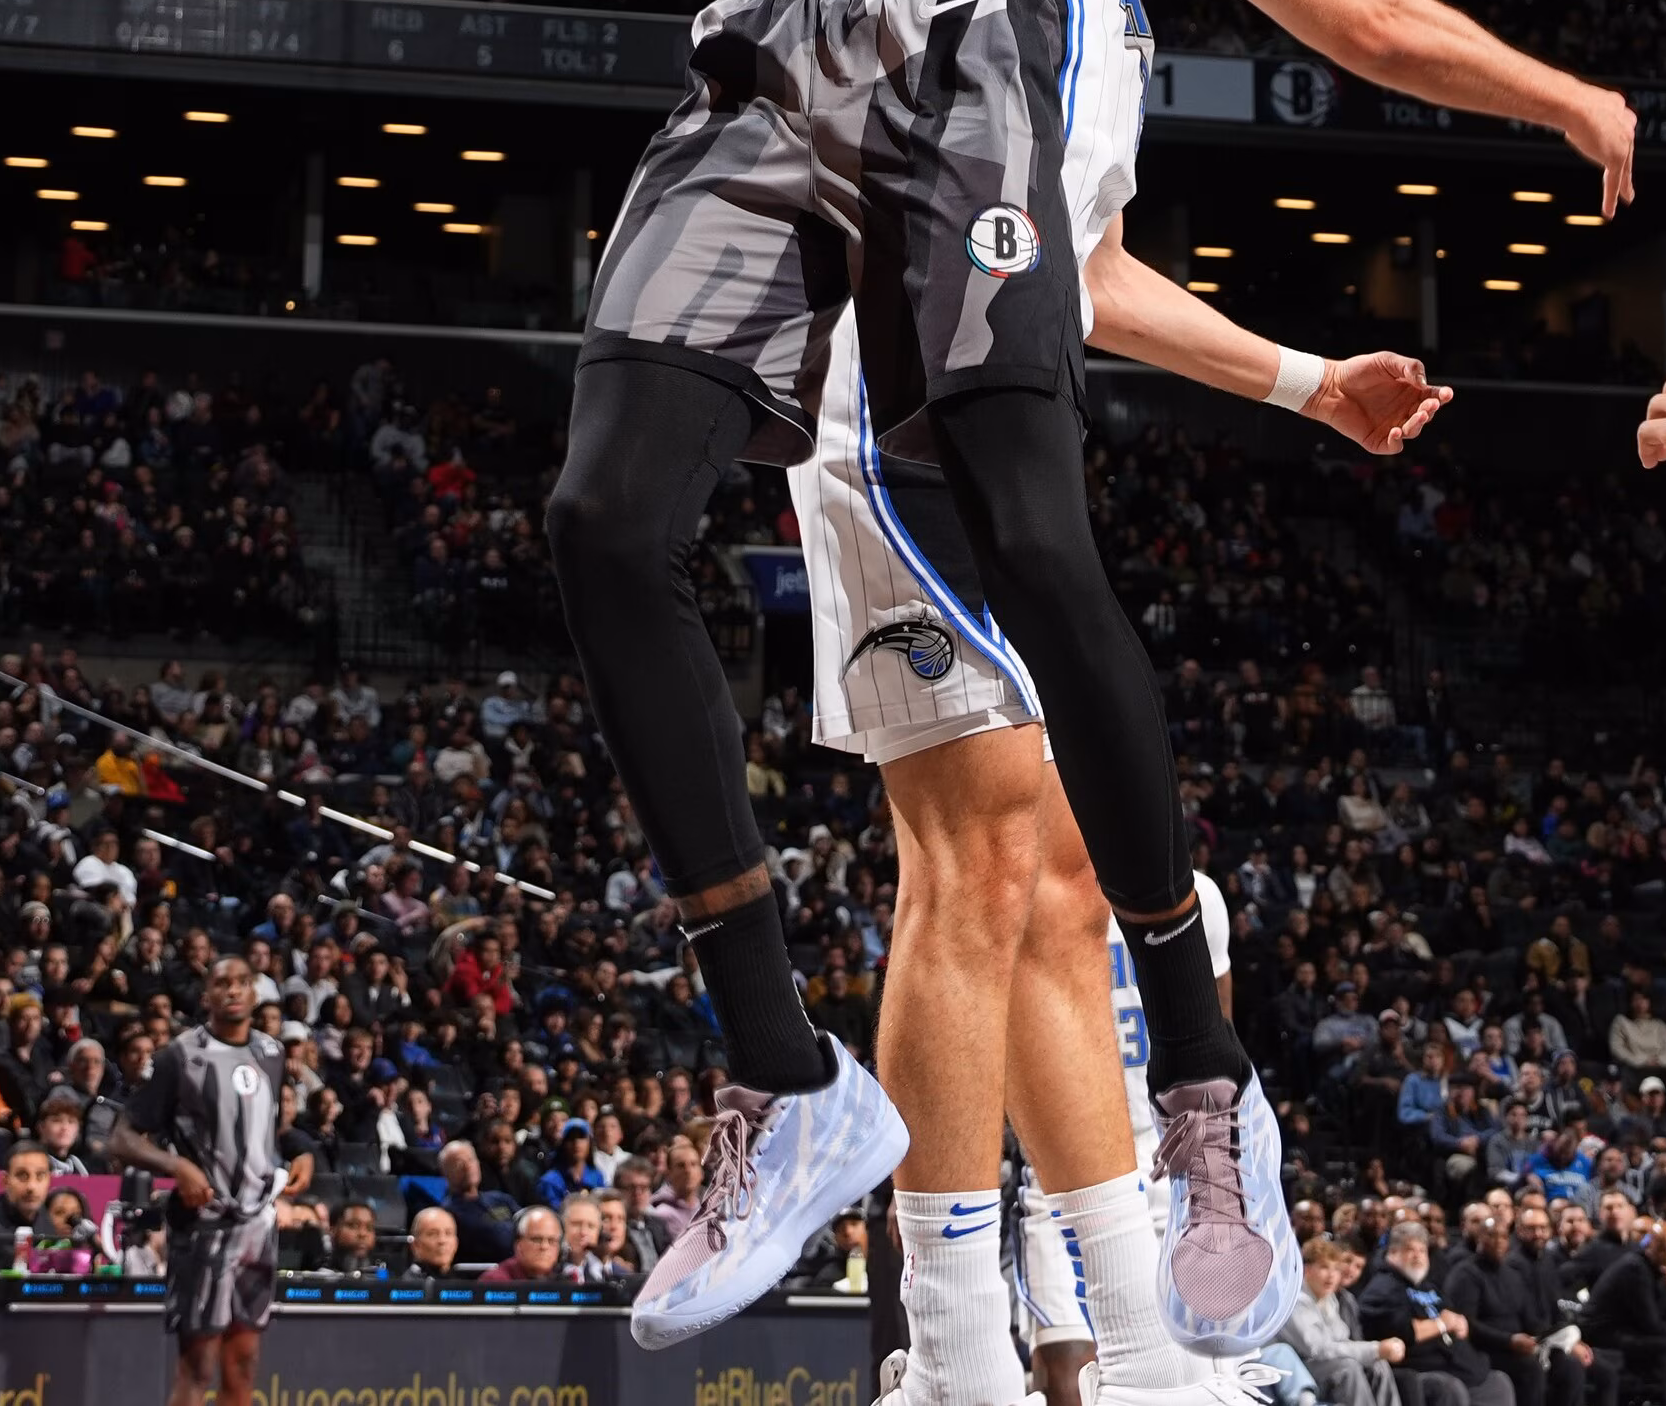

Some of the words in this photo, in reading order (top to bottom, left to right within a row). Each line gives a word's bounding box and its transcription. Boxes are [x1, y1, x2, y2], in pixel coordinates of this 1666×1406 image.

[458, 12, 509, 37] AST
[540, 47, 598, 75] TOL:
[603, 52, 619, 76] 7
[993, 214, 1019, 262] B
